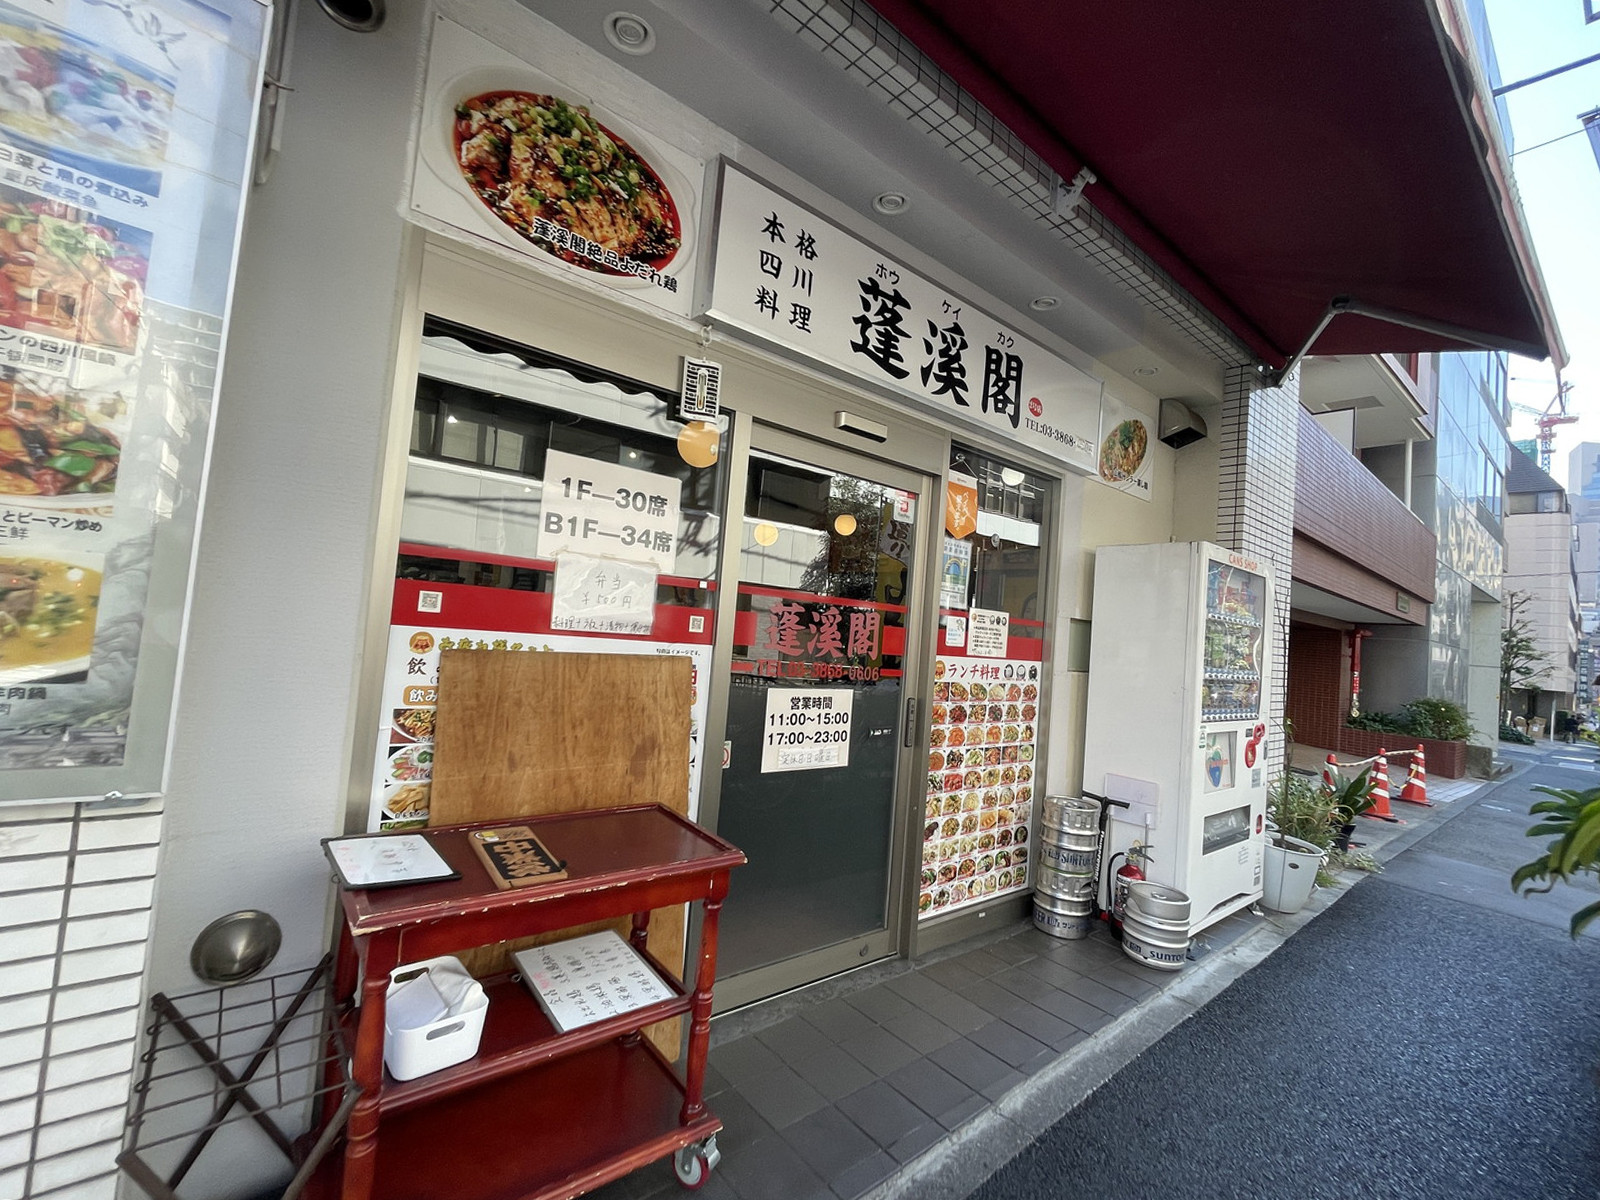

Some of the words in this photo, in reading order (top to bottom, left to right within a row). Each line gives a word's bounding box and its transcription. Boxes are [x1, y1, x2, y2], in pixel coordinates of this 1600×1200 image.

[761, 211, 818, 261] 本格
[760, 250, 813, 297] 四川
[875, 263, 900, 285] ホウ
[754, 285, 812, 334] 料理
[941, 299, 962, 321] ケイ
[996, 331, 1015, 349] カク
[595, 570, 621, 590] 弁当
[948, 663, 1001, 680] ランチ料理
[790, 696, 833, 710] 営業時間
